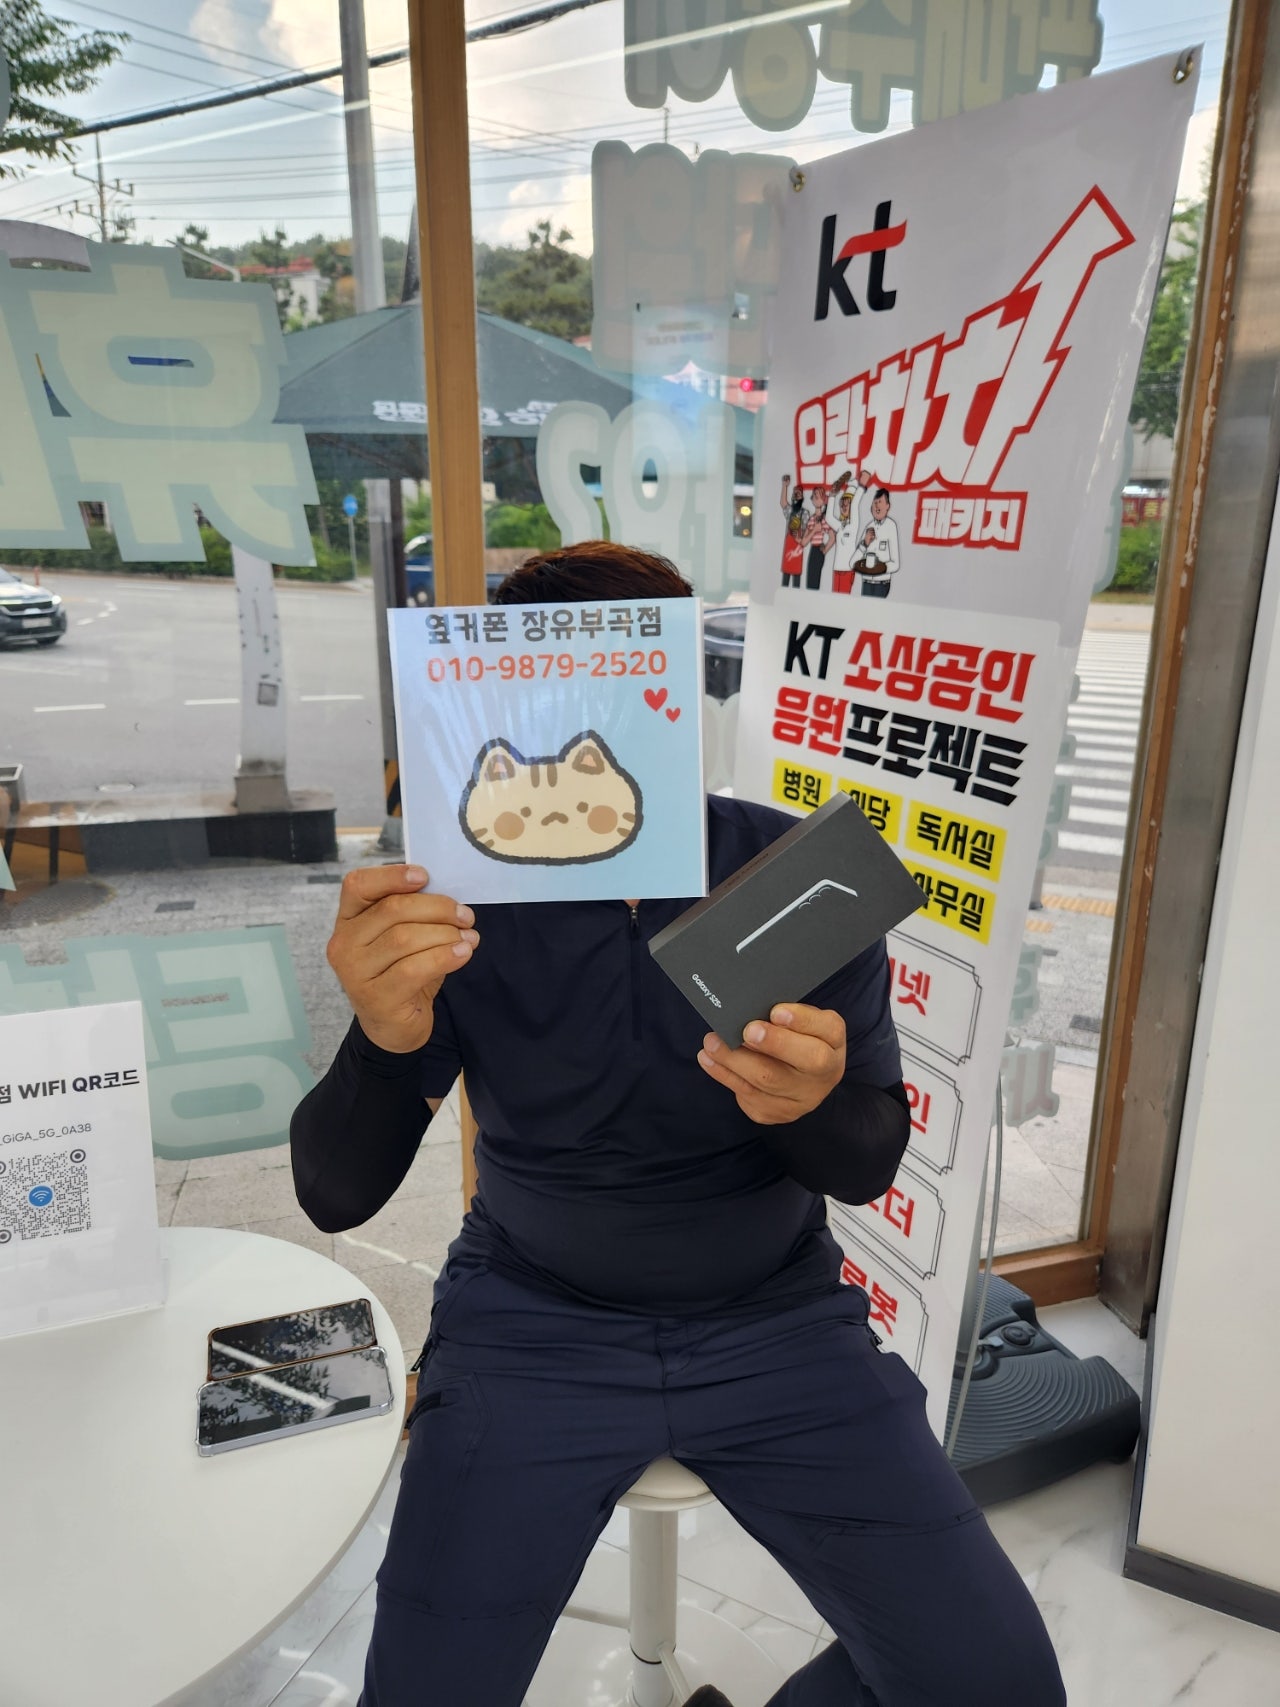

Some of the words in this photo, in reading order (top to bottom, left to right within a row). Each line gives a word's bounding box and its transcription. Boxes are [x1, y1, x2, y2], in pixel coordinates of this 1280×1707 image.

[814, 200, 907, 321] kt
[917, 498, 1022, 544] 패키지
[425, 612, 509, 645] 옆커폰
[521, 606, 662, 643] 장유부곡점
[427, 650, 667, 682] 010-9879-2520
[783, 621, 846, 680] KT
[843, 630, 1037, 724] 소상공인
[783, 767, 822, 808] 병원
[917, 811, 995, 871] 독서실
[692, 973, 712, 997] Galaxy
[18, 1078, 66, 1100] WIFI
[72, 1069, 140, 1093] QR코드
